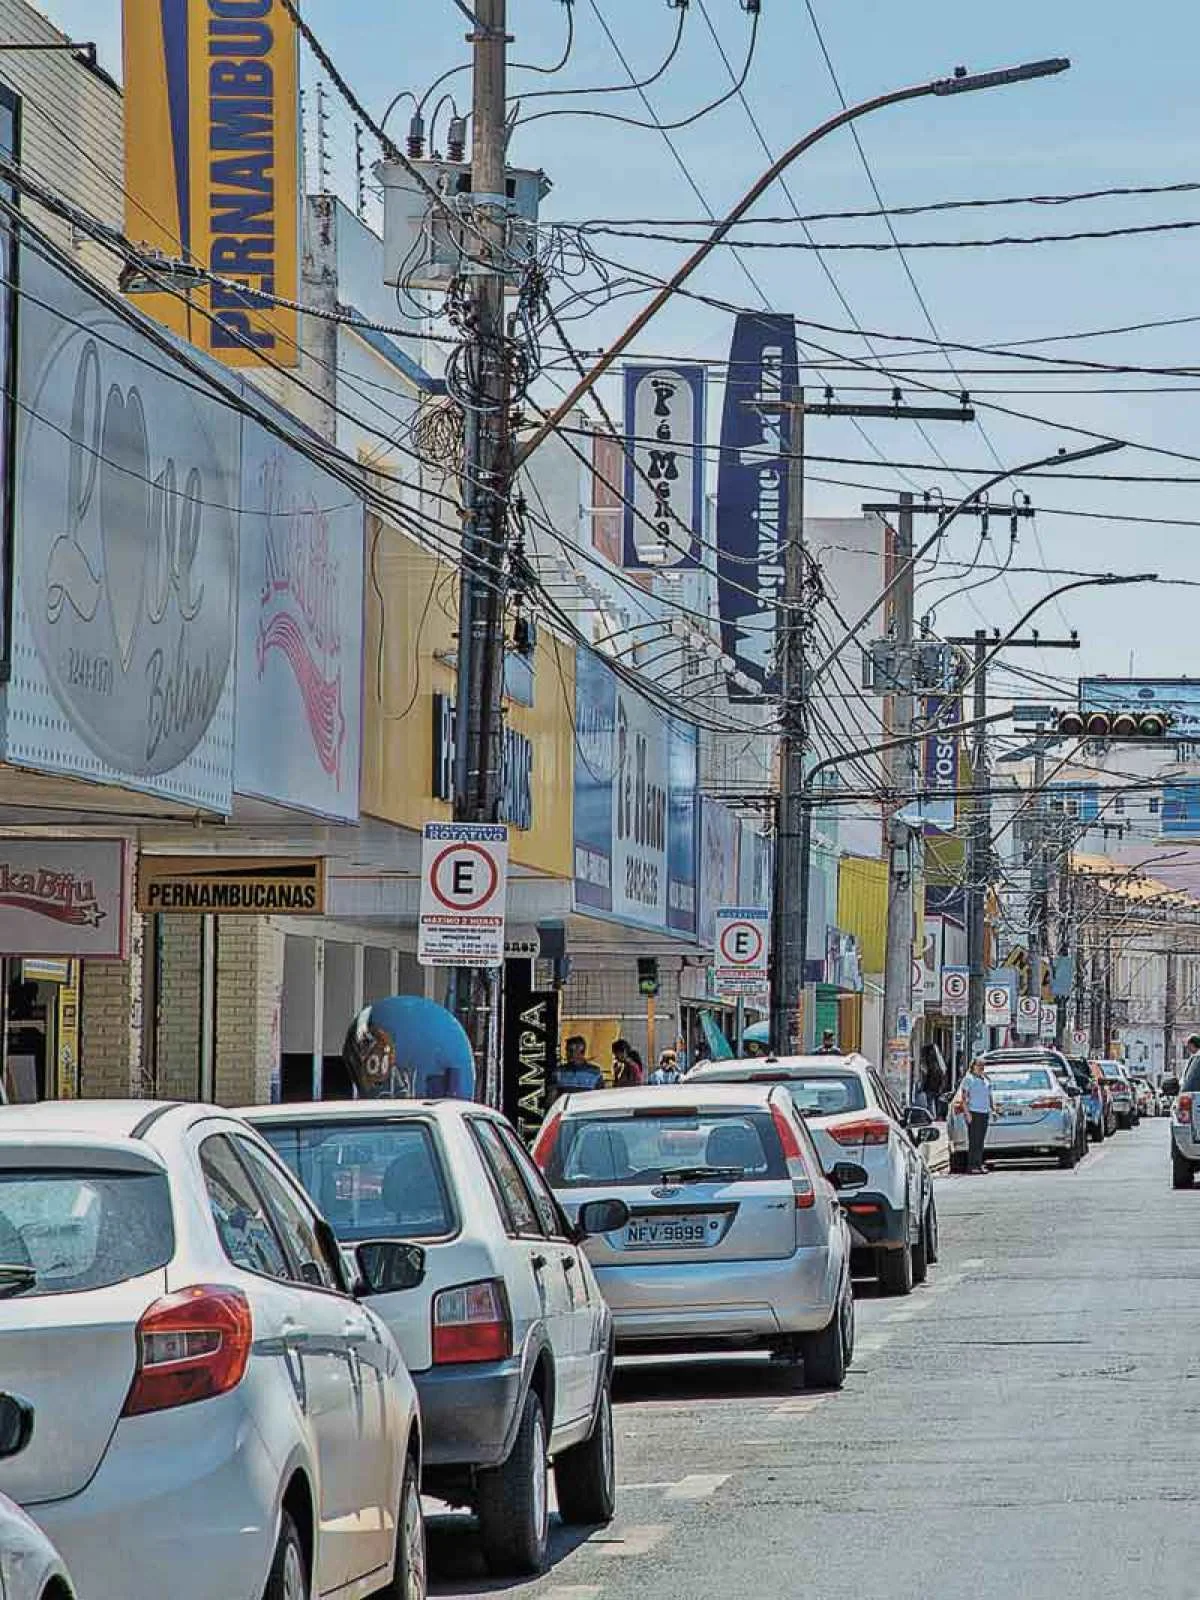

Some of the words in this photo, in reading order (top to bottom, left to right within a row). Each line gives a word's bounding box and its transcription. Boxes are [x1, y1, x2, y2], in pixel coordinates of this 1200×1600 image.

[430, 831, 504, 841] ROTATIVO
[453, 860, 474, 894] E
[148, 883, 316, 909] PERNAMBUCANAS
[735, 932, 749, 954] E
[951, 978, 961, 992] E
